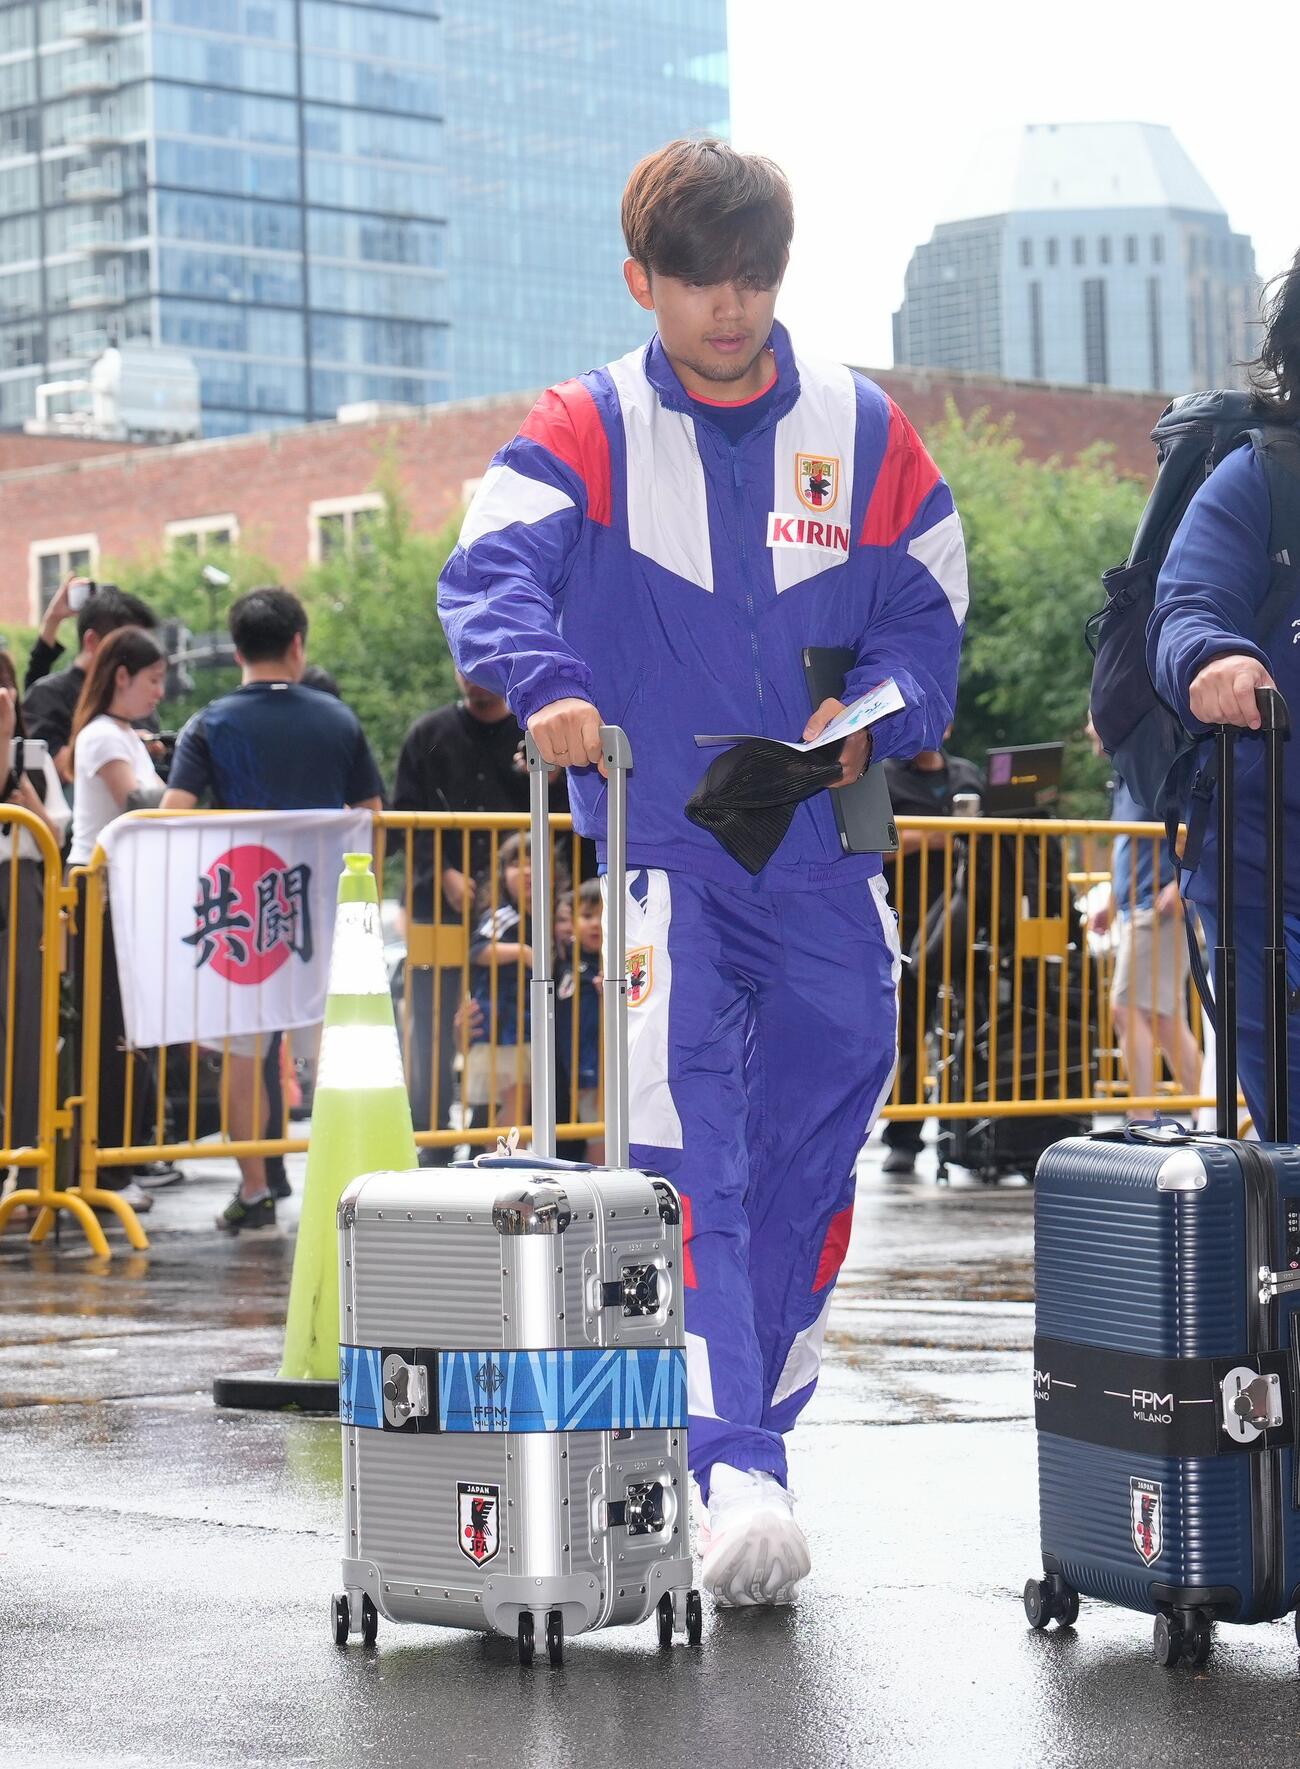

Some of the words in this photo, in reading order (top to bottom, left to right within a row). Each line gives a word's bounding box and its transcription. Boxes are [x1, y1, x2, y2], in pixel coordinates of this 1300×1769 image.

[772, 517, 850, 552] KIRIN
[182, 863, 313, 968] 共闘
[1132, 1389, 1174, 1412] FPM
[473, 1406, 508, 1418] FPM
[1133, 1410, 1173, 1424] MILANO
[466, 1485, 490, 1494] JAPAN
[1137, 1481, 1155, 1491] JAPAN
[469, 1539, 489, 1554] JFA
